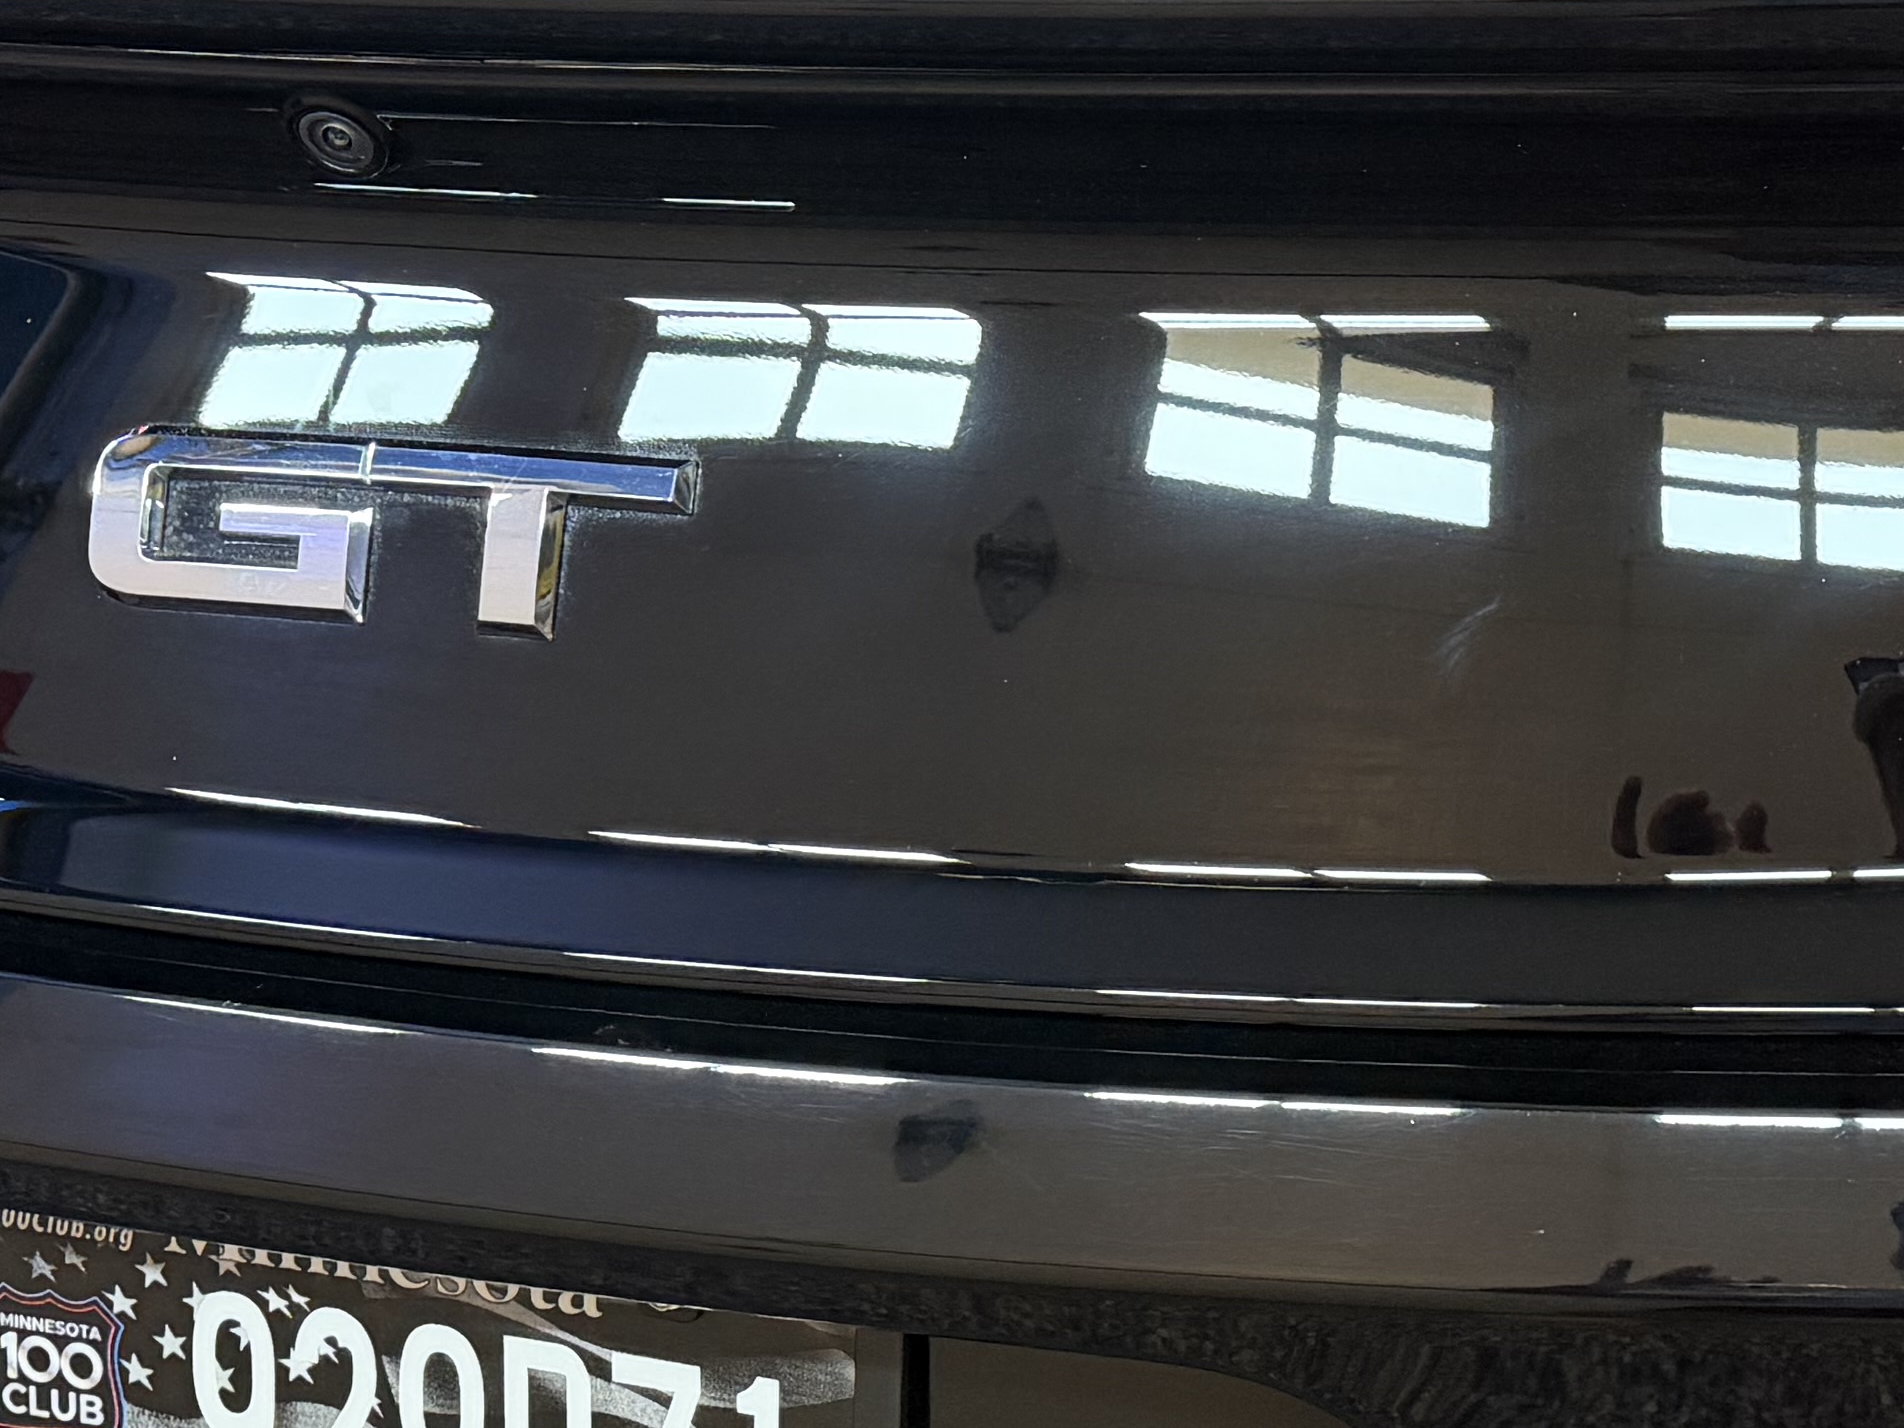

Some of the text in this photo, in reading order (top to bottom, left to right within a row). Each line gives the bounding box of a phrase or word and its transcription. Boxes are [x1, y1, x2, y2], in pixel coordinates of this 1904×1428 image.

[89, 425, 701, 641] GT
[0, 1312, 102, 1342] MINNESOTA
[0, 1331, 104, 1390] 100
[1, 1382, 105, 1426] CLUB
